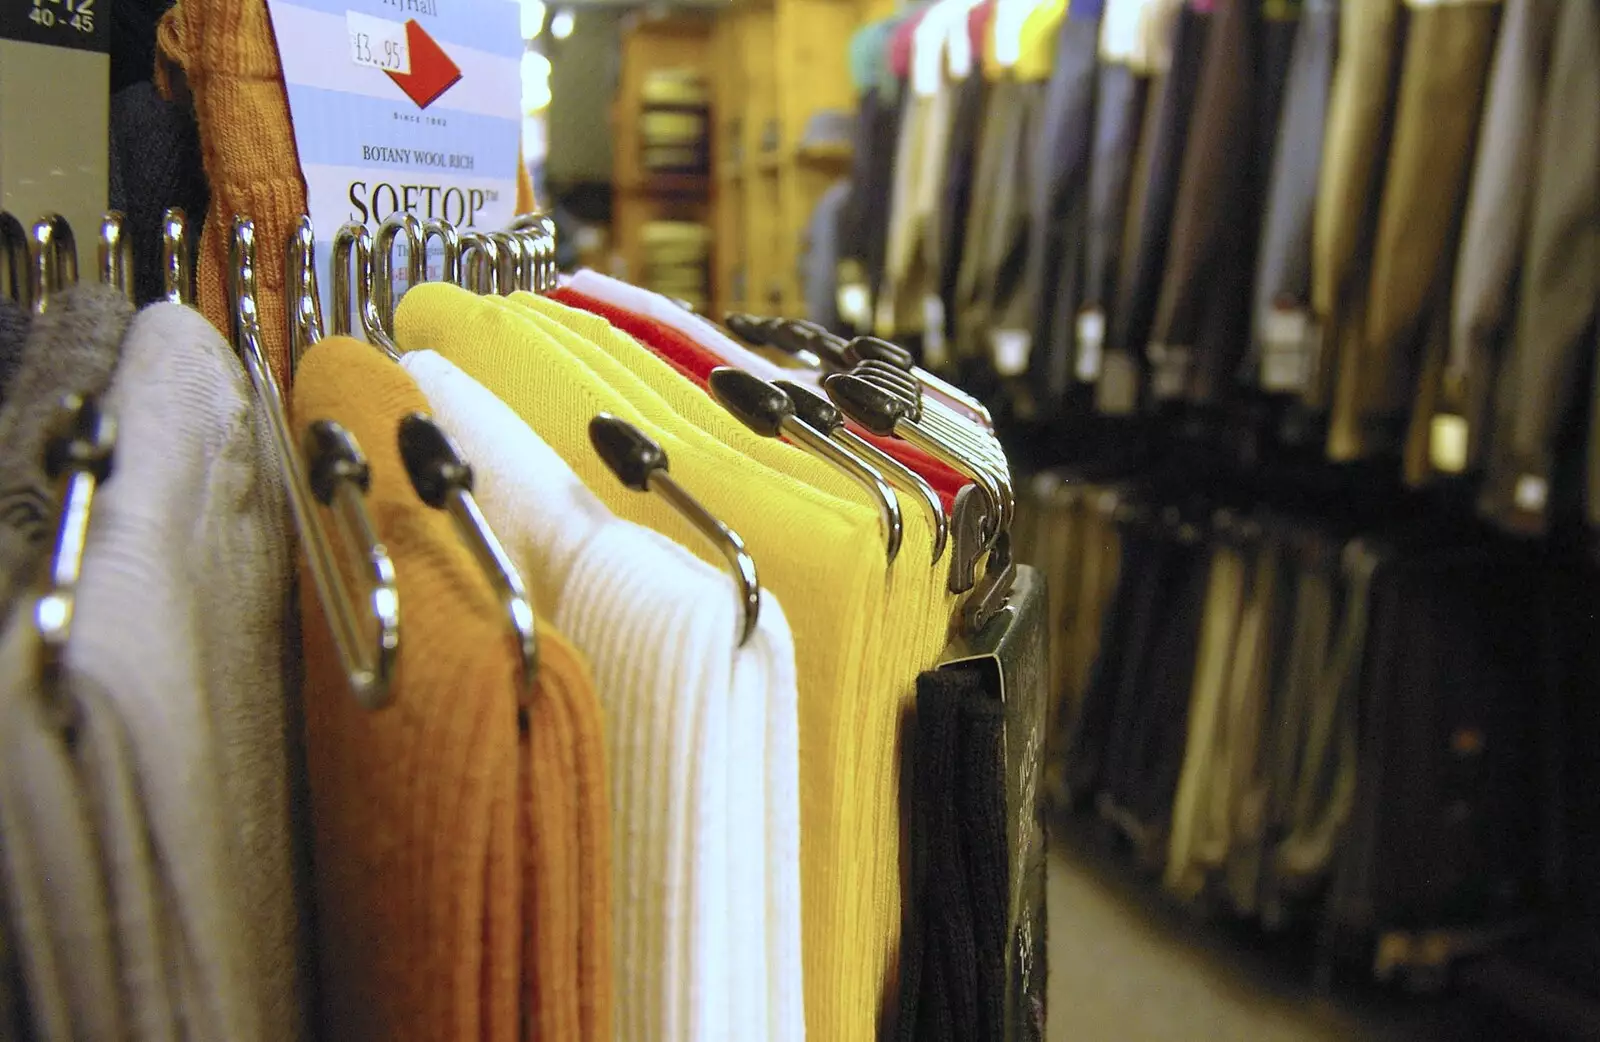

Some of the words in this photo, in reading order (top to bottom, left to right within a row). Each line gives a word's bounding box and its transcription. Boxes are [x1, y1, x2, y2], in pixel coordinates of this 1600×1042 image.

[362, 145, 411, 164] BOTANY
[413, 150, 447, 168] WOOL
[449, 154, 474, 169] RICH
